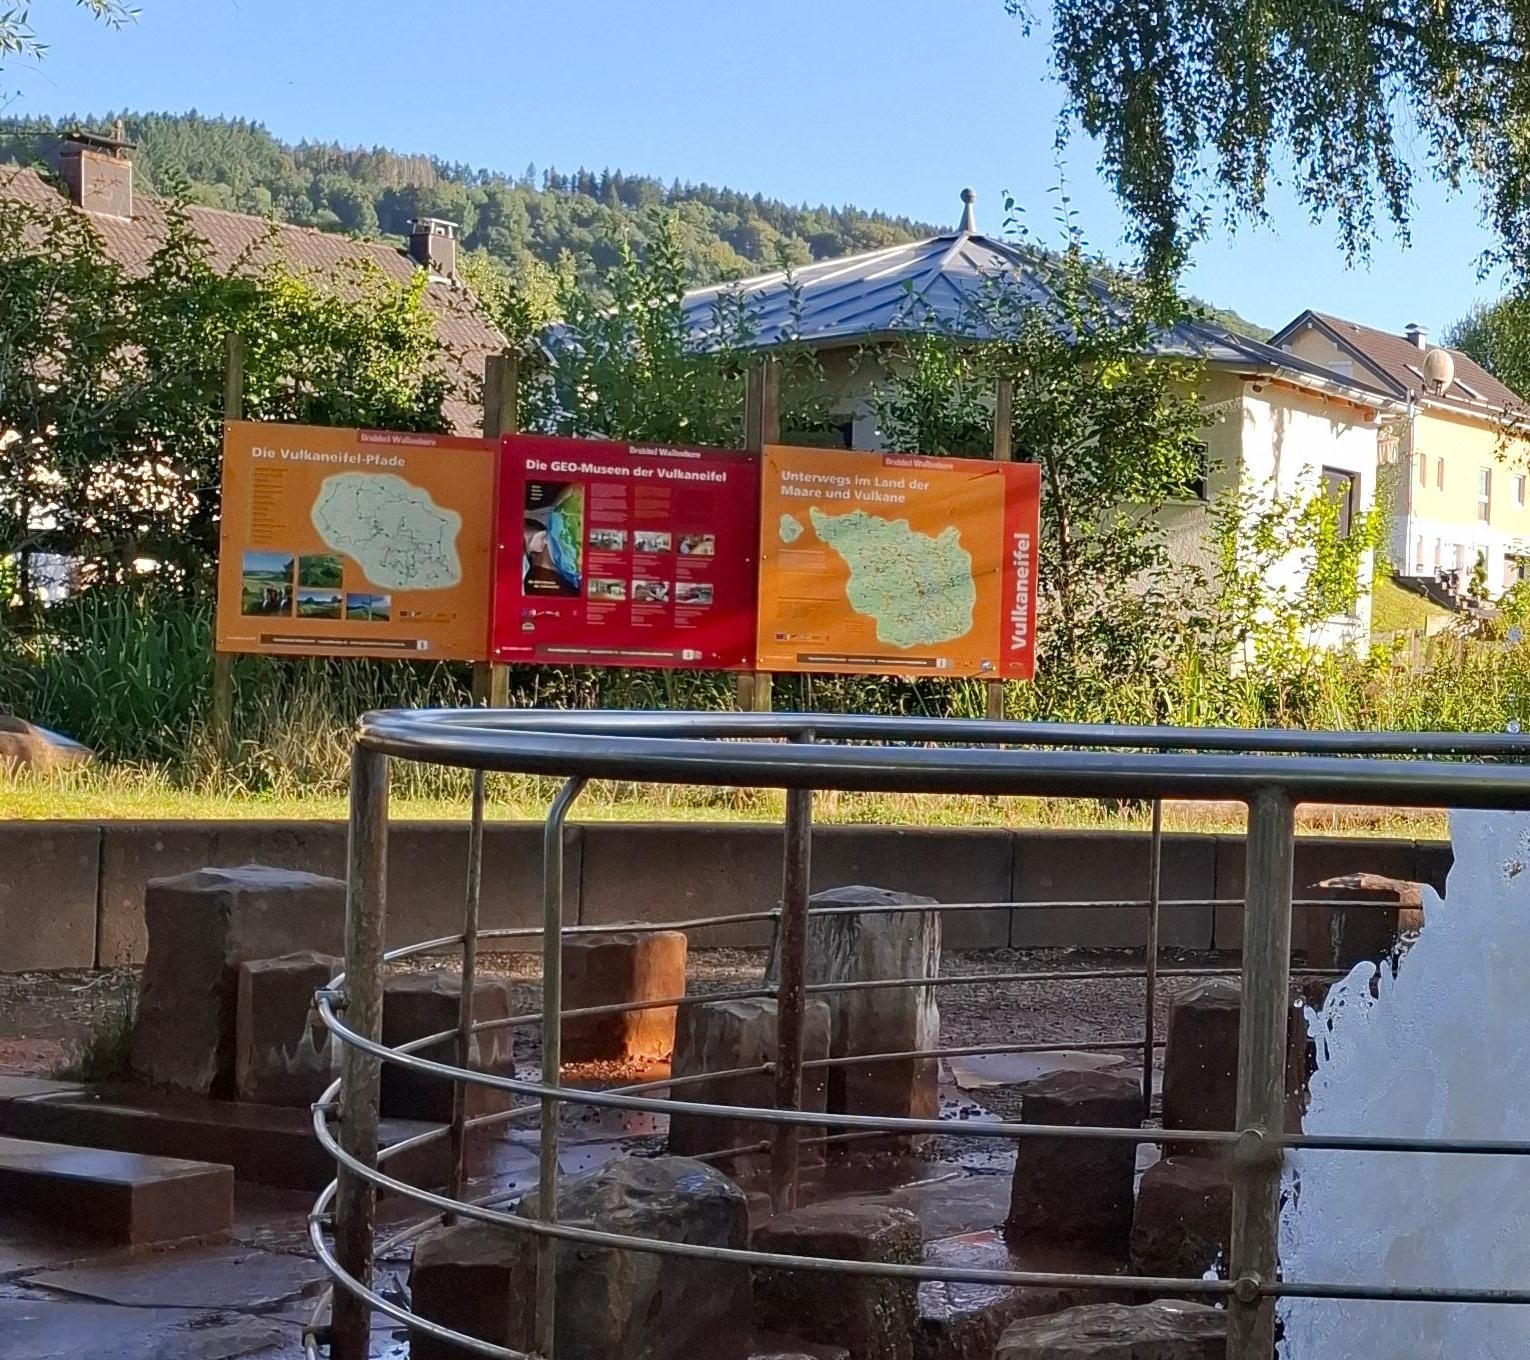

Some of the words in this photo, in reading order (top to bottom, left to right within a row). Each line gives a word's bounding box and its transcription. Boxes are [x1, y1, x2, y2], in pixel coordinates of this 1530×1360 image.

[252, 446, 276, 459] Die
[280, 448, 406, 467] Vulkaneifel-Pfade
[525, 459, 548, 471] Die
[551, 461, 630, 476] GEO-Museen
[633, 466, 653, 478] der
[657, 468, 727, 482] Vulkaneifel
[781, 470, 851, 486] Unterwegs
[855, 475, 871, 487] im
[874, 476, 905, 489] Land
[909, 479, 930, 491] der
[781, 486, 822, 498] Maare
[826, 487, 851, 499] und
[854, 490, 906, 503] Vulkane
[1010, 533, 1031, 651] Vulkaneifel
